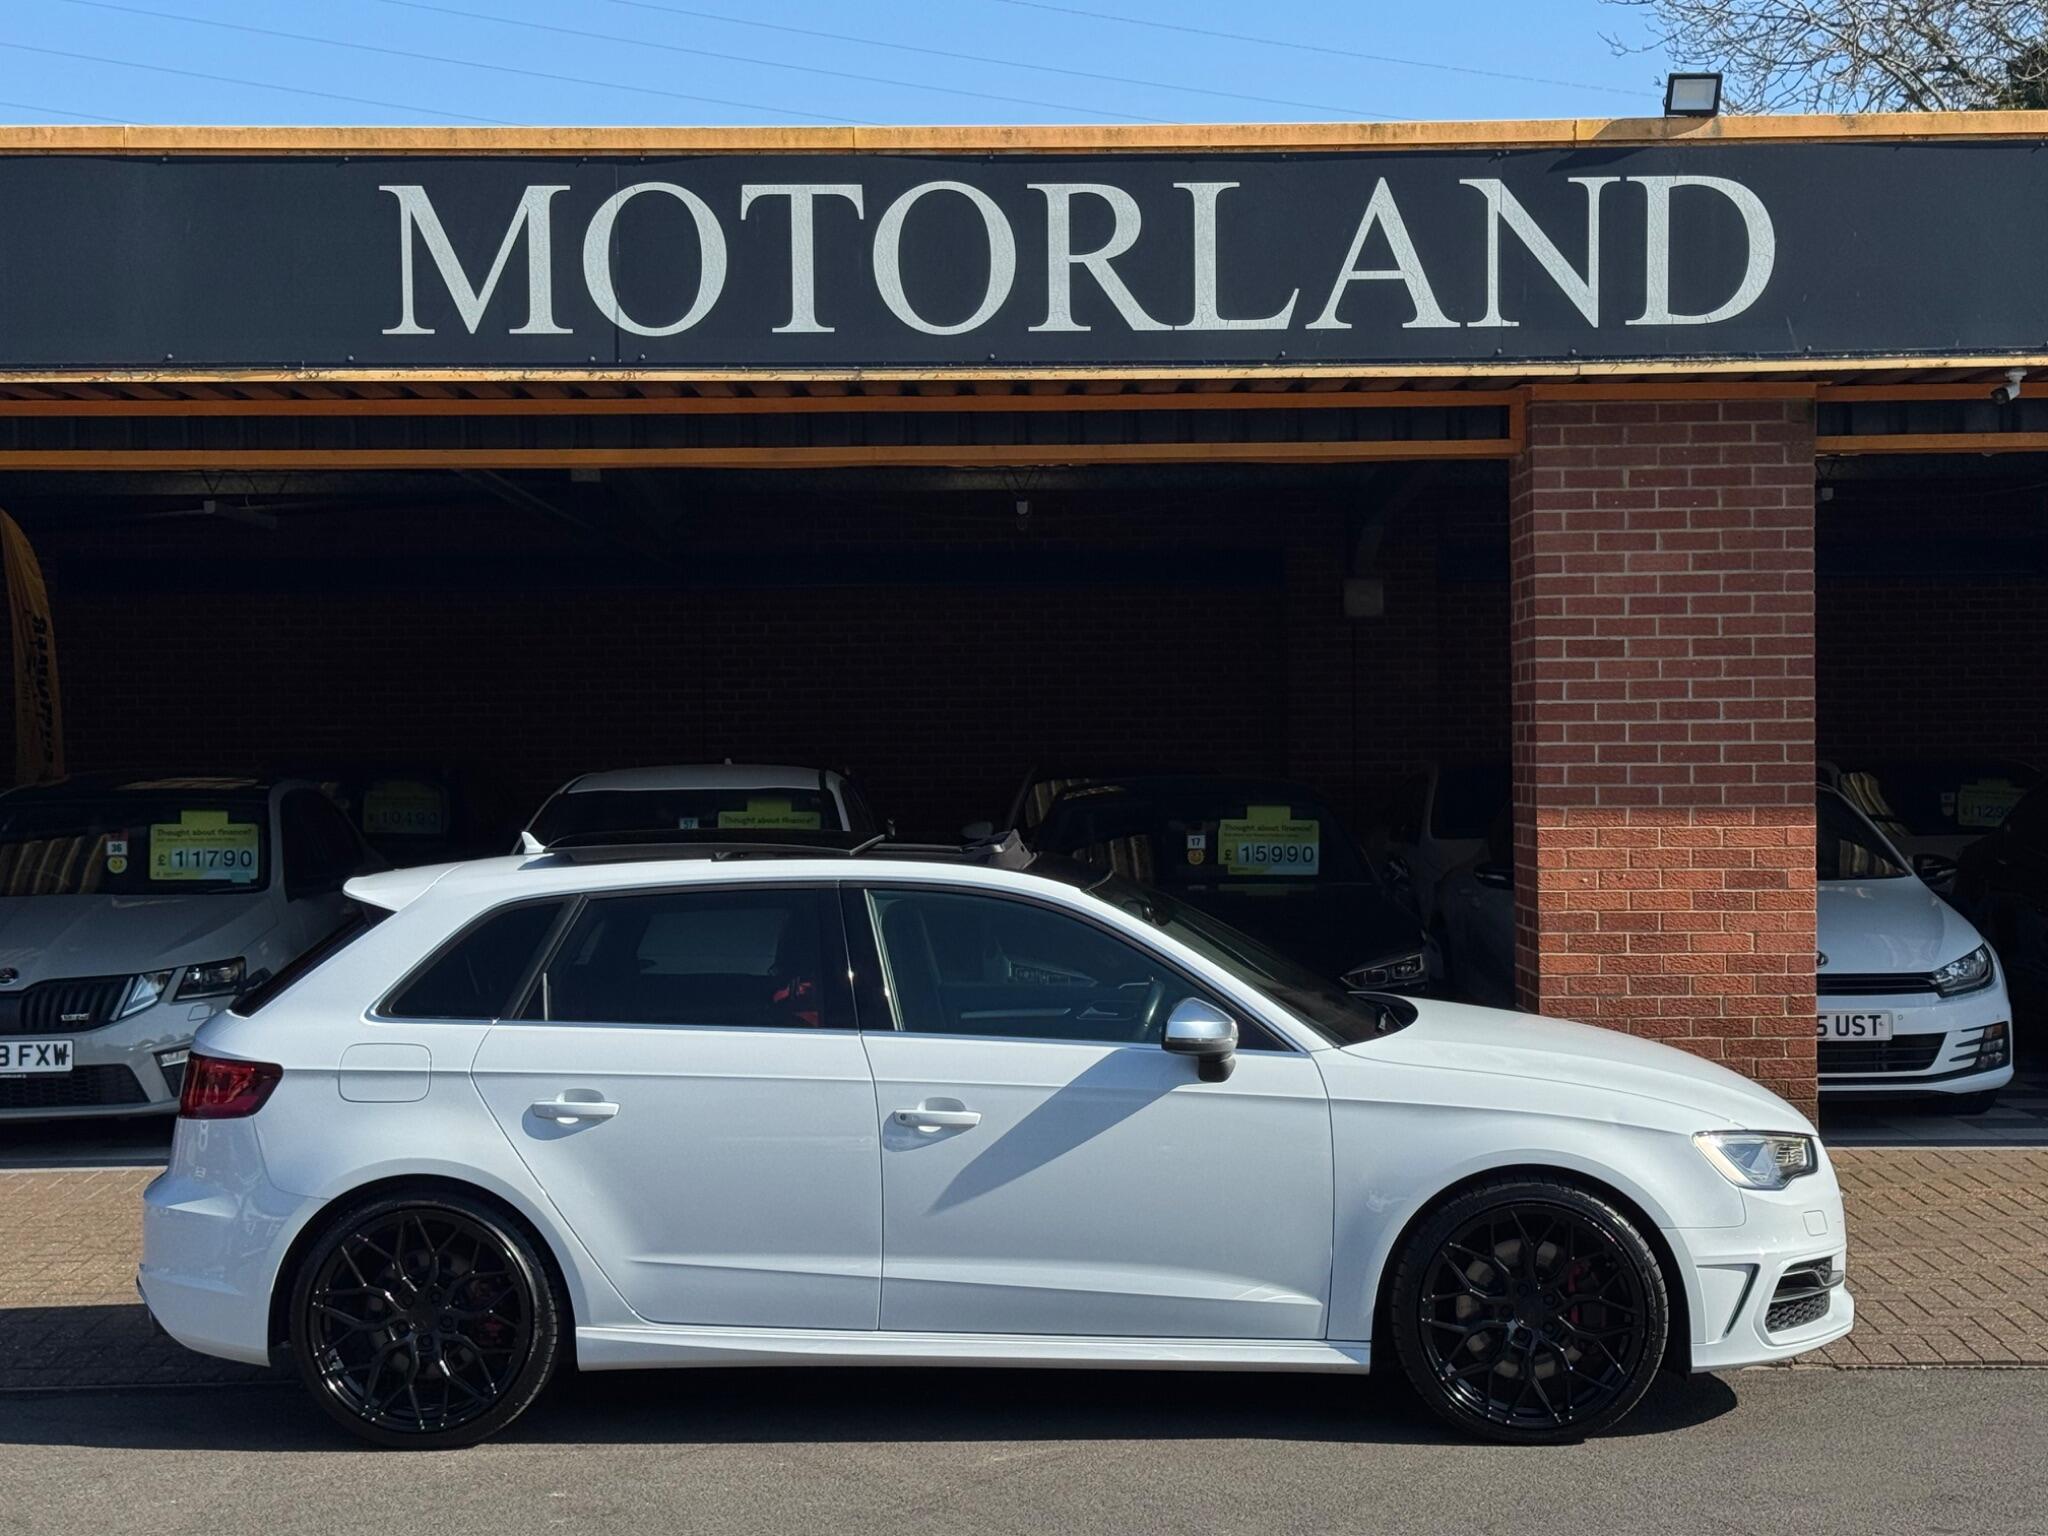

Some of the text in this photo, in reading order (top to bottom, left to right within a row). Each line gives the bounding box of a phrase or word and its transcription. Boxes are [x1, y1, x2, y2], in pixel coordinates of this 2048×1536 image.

[379, 176, 1776, 336] MOTORLAND
[757, 816, 780, 824] about
[192, 828, 216, 836] about
[111, 843, 122, 853] 36
[1224, 845, 1314, 863] £ 15990
[157, 849, 252, 868] £ 11790
[1835, 1014, 1882, 1037] UST
[18, 1043, 68, 1067] FXW
